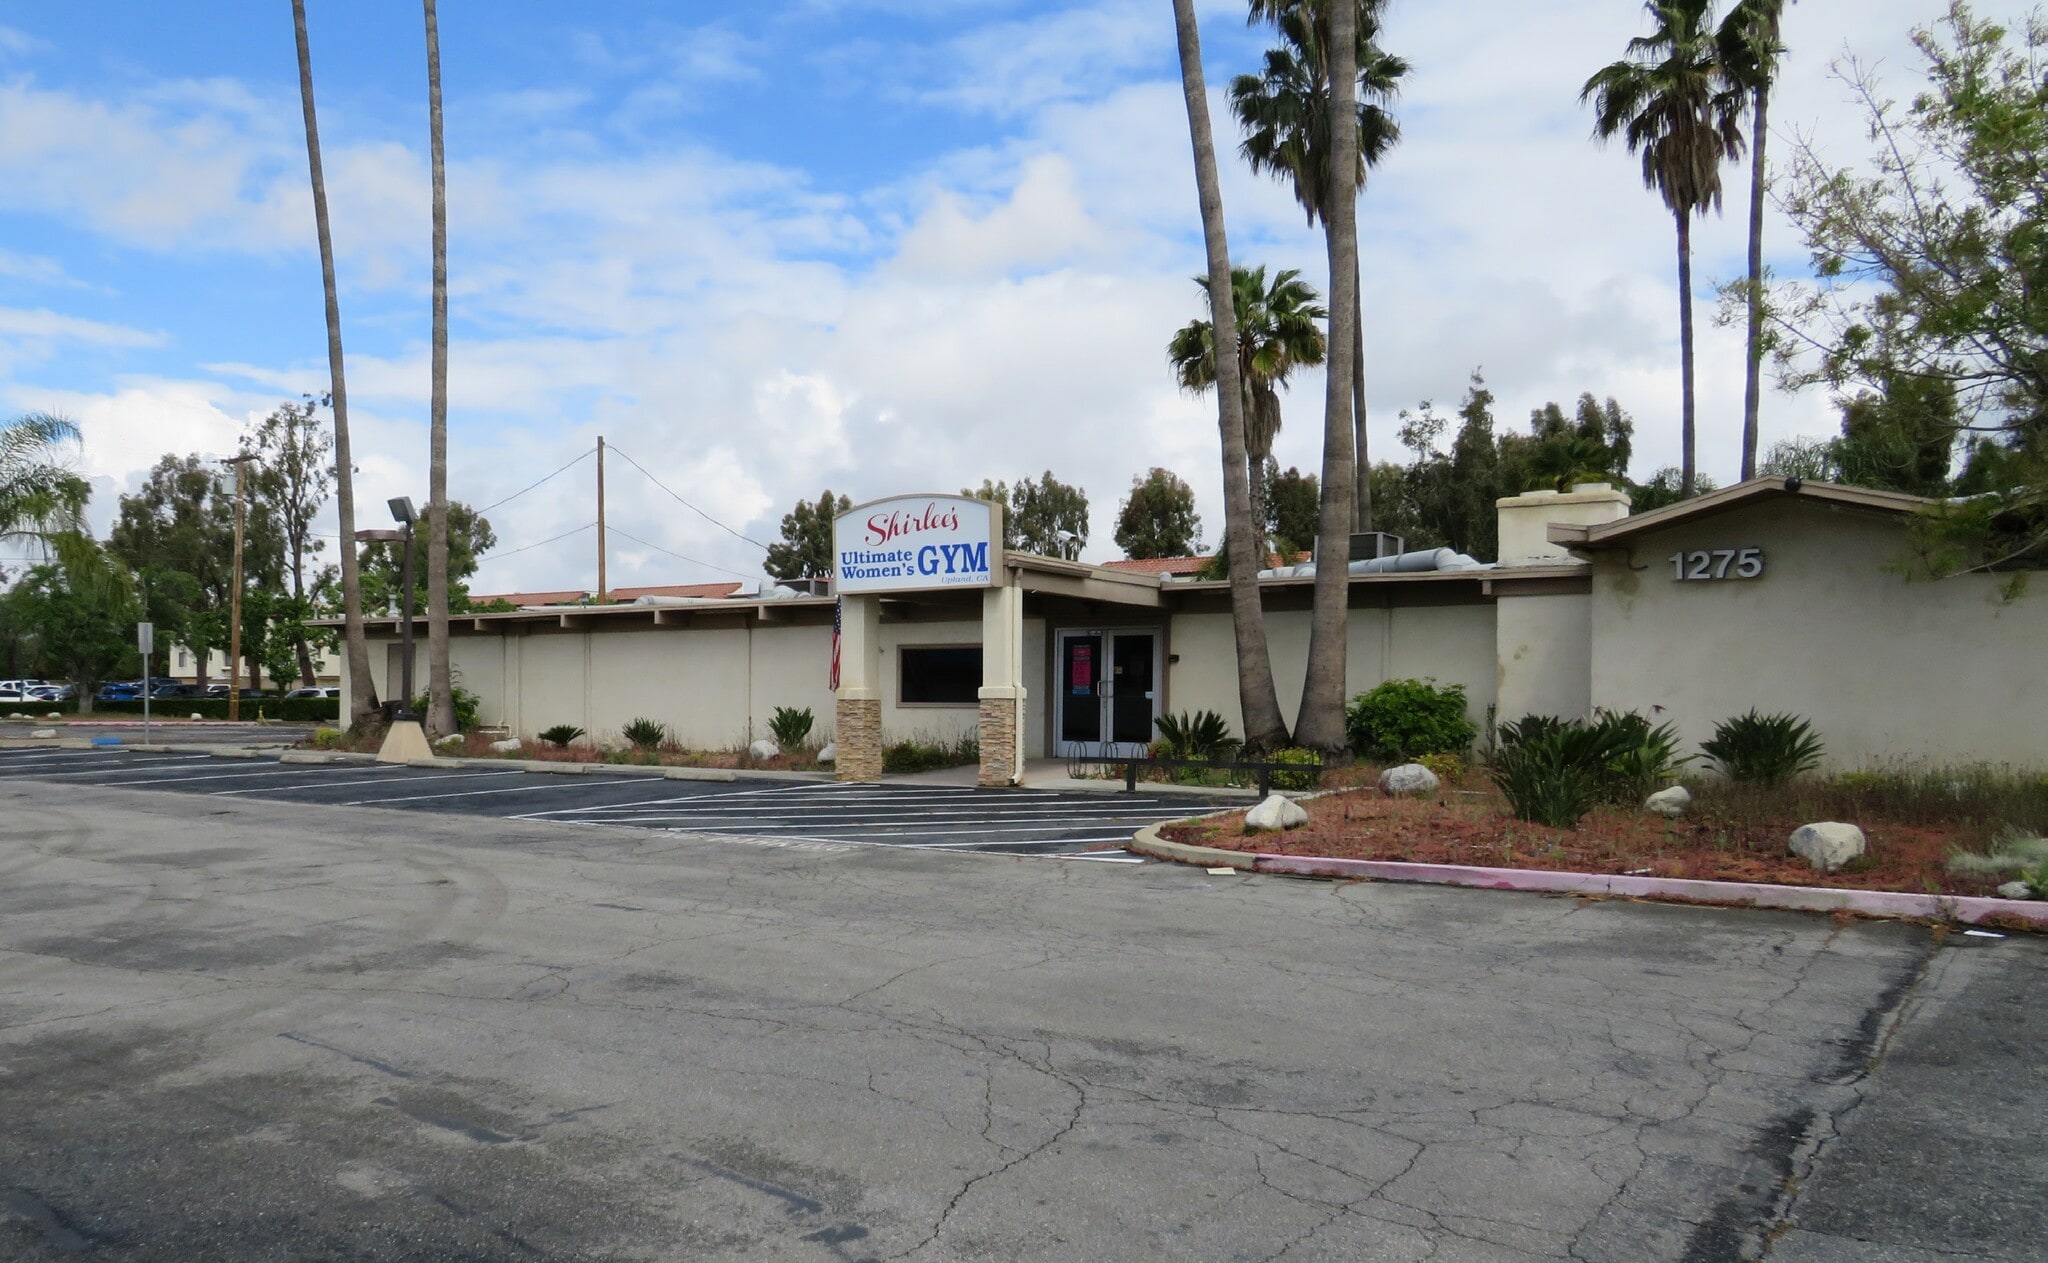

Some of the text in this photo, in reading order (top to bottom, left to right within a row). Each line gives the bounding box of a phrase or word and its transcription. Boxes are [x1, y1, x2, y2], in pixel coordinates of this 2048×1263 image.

[865, 502, 958, 546] Shirlee's
[841, 549, 913, 565] Ultimate
[841, 563, 915, 579] Women's
[918, 542, 988, 576] GYM
[1668, 548, 1763, 580] 1275
